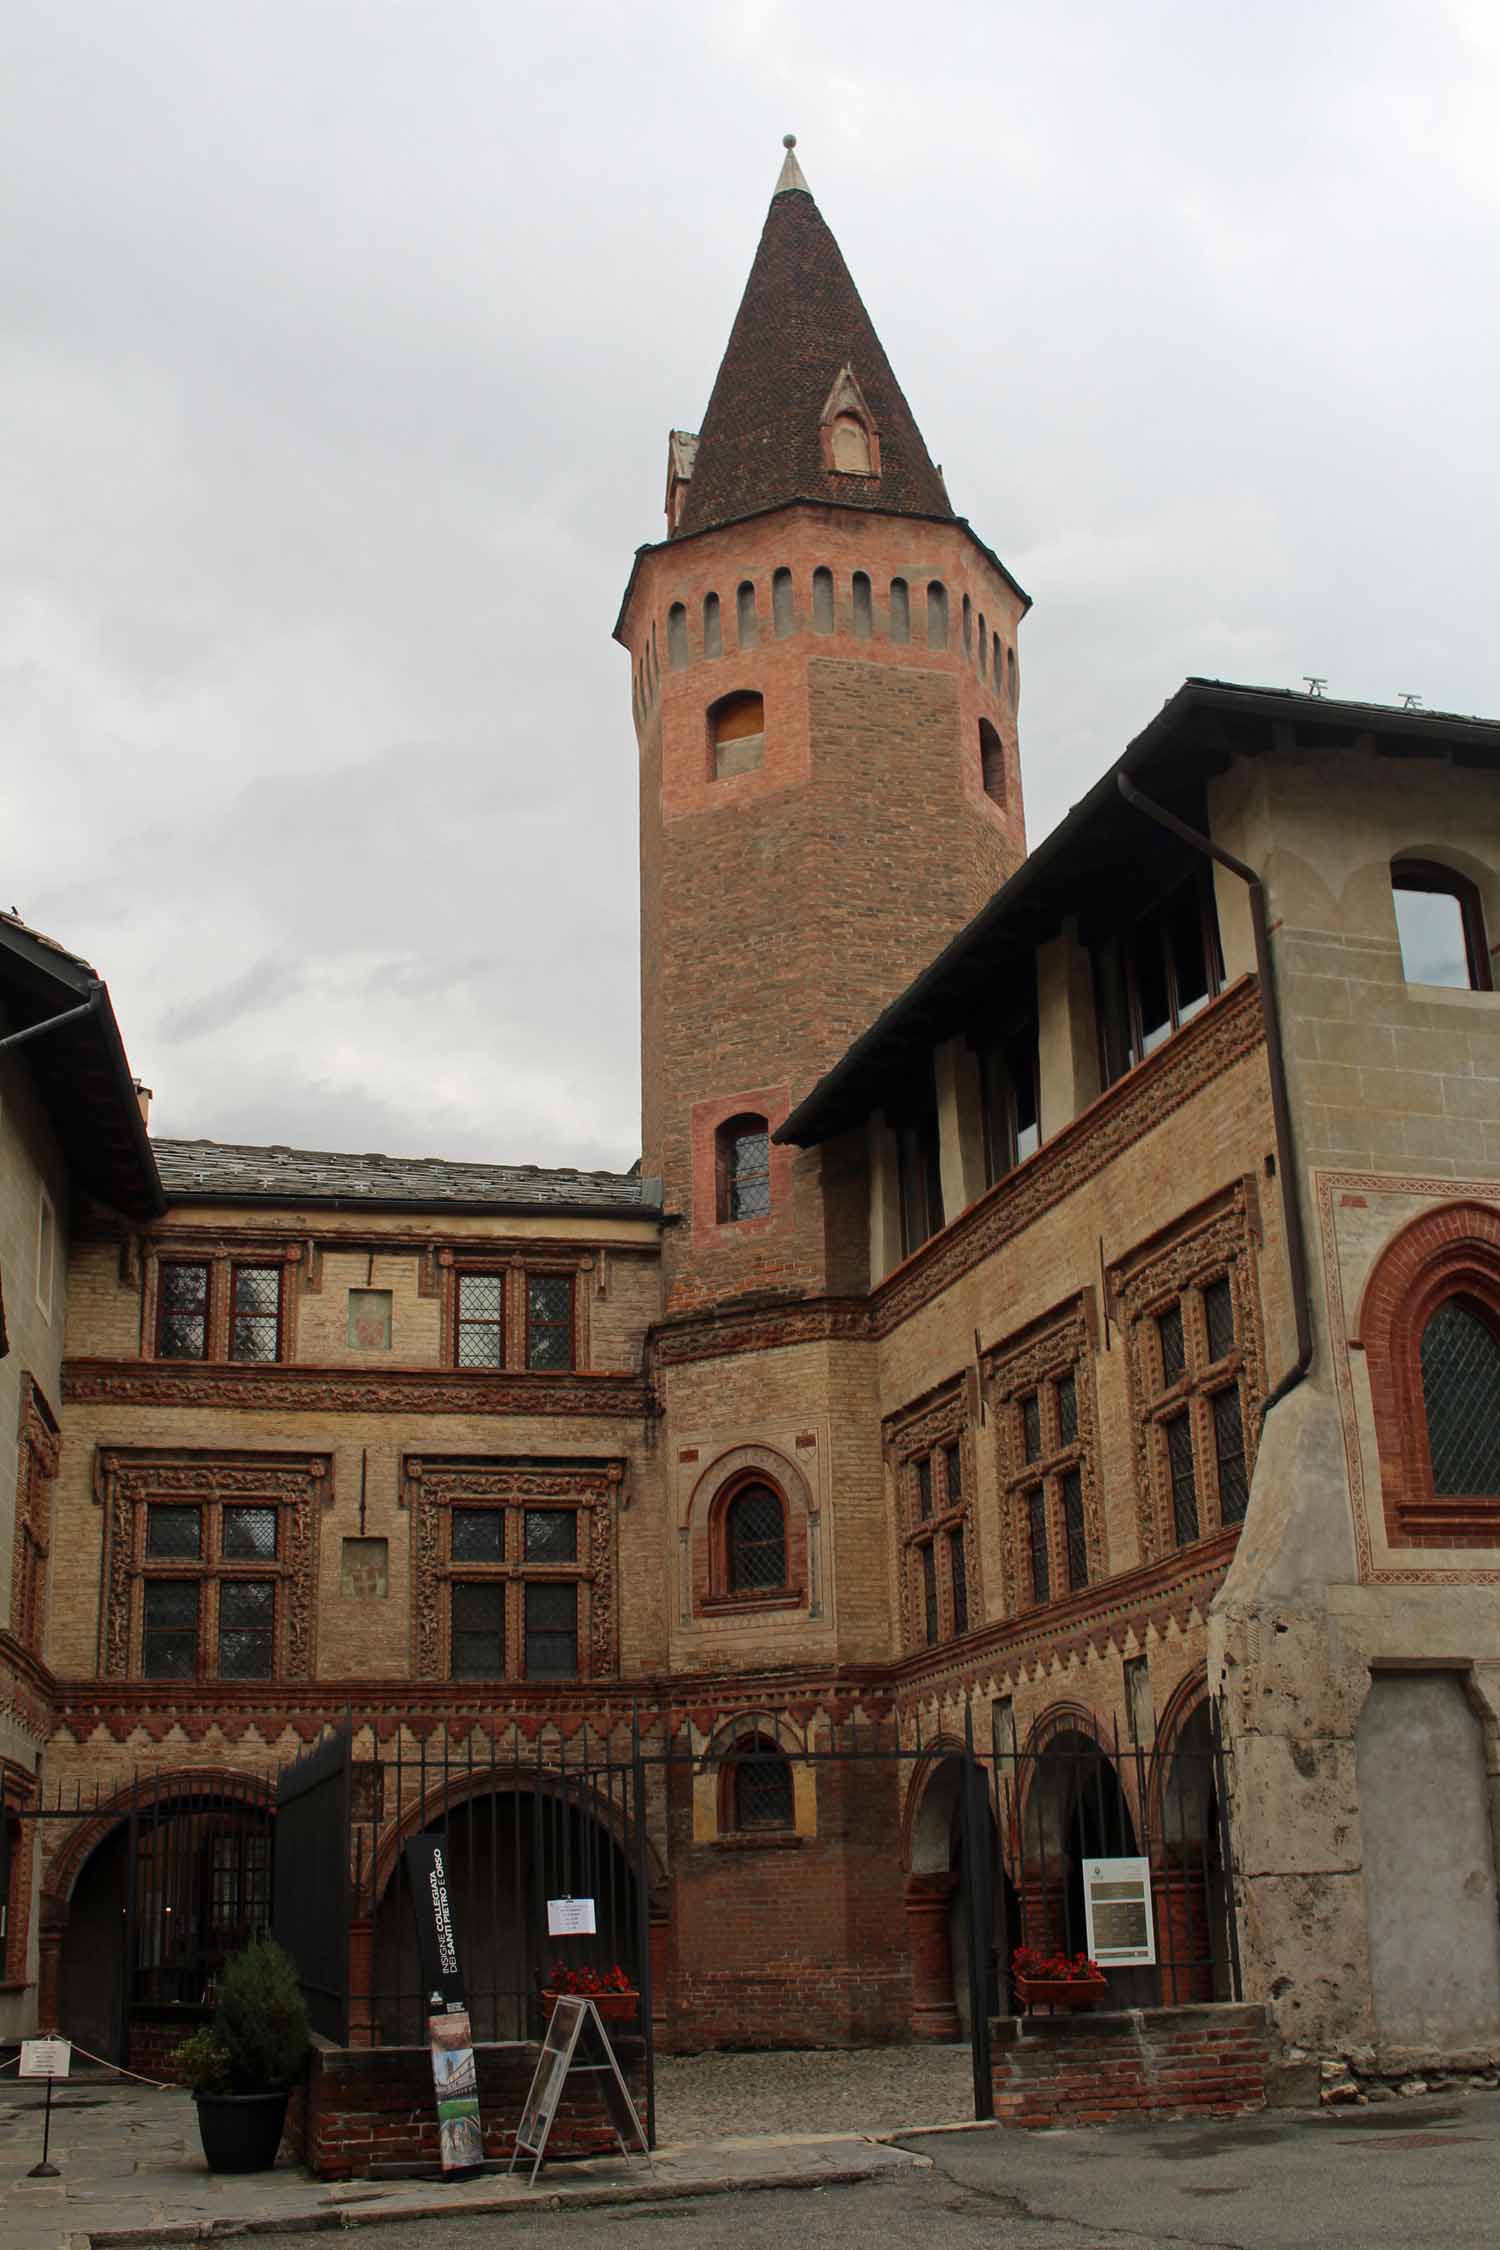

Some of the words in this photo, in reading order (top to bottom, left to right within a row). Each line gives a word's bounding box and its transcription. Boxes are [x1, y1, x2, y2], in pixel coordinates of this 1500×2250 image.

[434, 1848, 444, 1878] ORSO
[430, 1871, 444, 1932] COLLEGIATA
[440, 1887, 451, 1923] PIETRO
[438, 1934, 449, 1974] INSIGNE
[445, 1925, 455, 1955] SANTI
[449, 1956, 458, 1973] DEI
